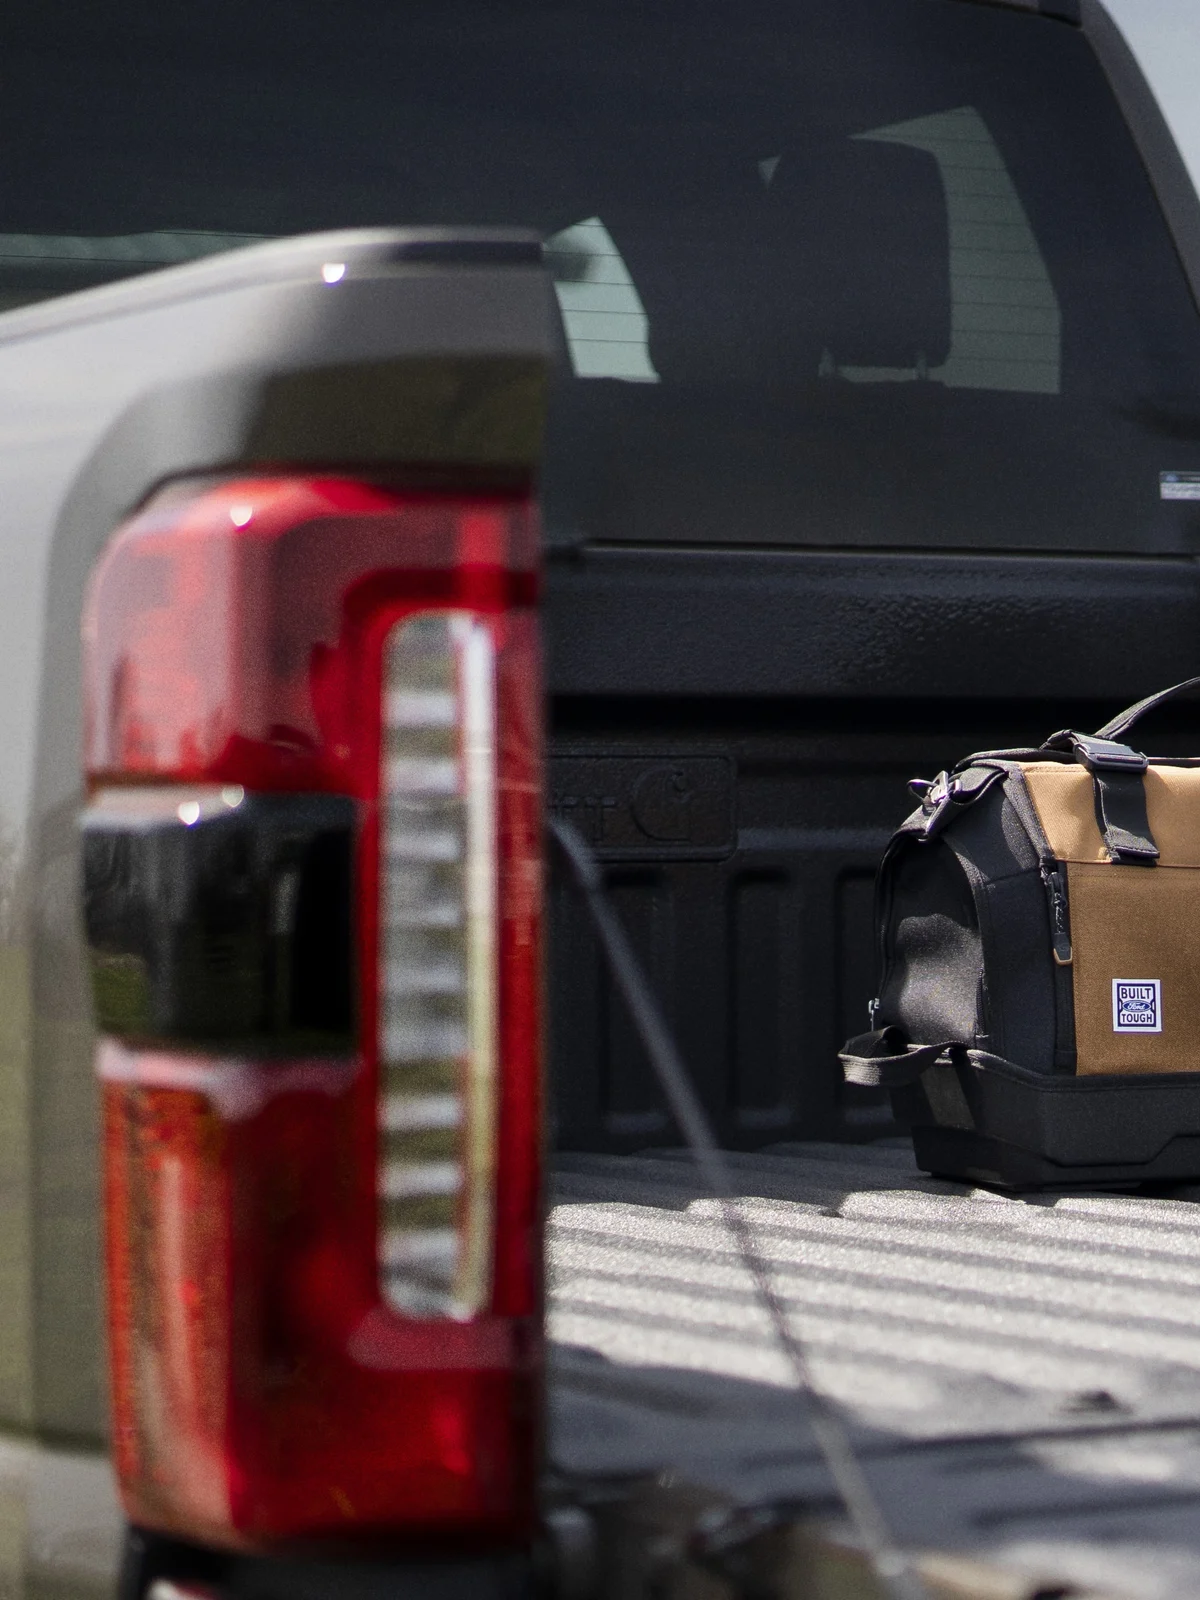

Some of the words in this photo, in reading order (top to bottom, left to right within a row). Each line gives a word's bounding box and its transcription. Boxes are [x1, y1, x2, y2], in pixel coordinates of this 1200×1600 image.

[1121, 988, 1151, 999] BUILT
[1127, 1002, 1146, 1011] Ford
[1121, 1013, 1153, 1023] TOUGH
